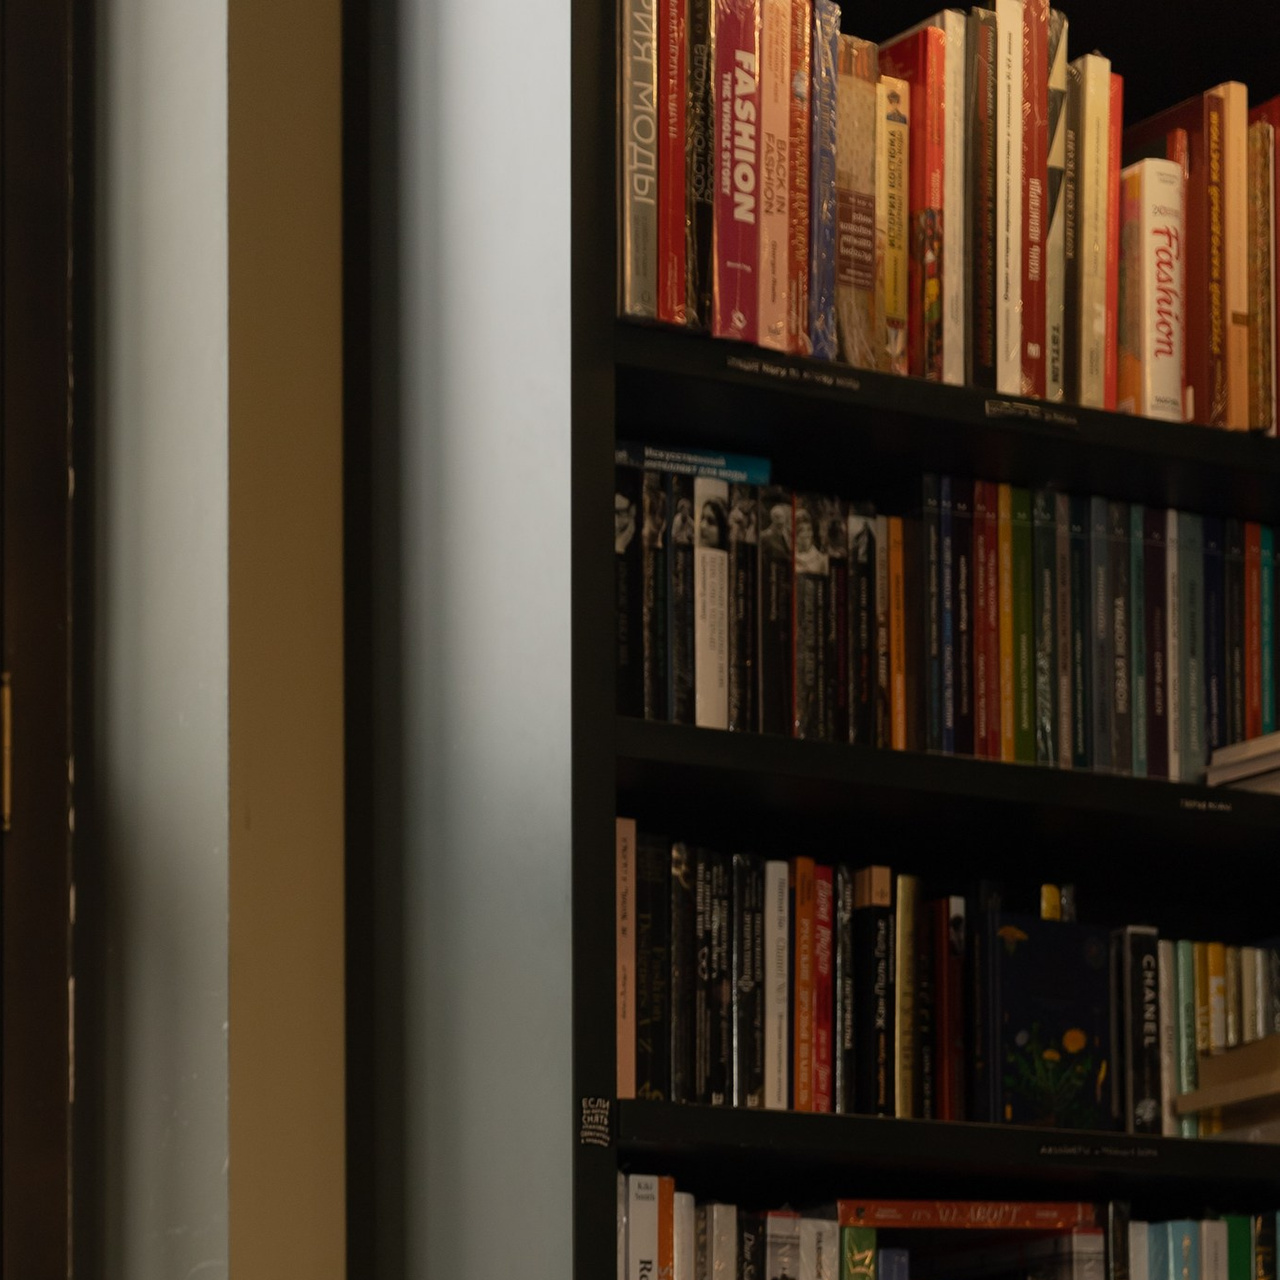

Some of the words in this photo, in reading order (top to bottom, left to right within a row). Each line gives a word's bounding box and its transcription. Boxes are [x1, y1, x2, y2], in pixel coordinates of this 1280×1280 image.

[722, 72, 732, 98] THE
[722, 99, 732, 149] WHOLE
[733, 50, 756, 223] FASHION
[722, 151, 733, 196] STORY
[763, 132, 775, 215] FASHION
[776, 140, 786, 191] BACK
[775, 194, 786, 215] IN
[1151, 226, 1179, 359] Fashion
[1142, 954, 1157, 1049] CHANEL
[582, 1098, 610, 1111] ЕСЛИ
